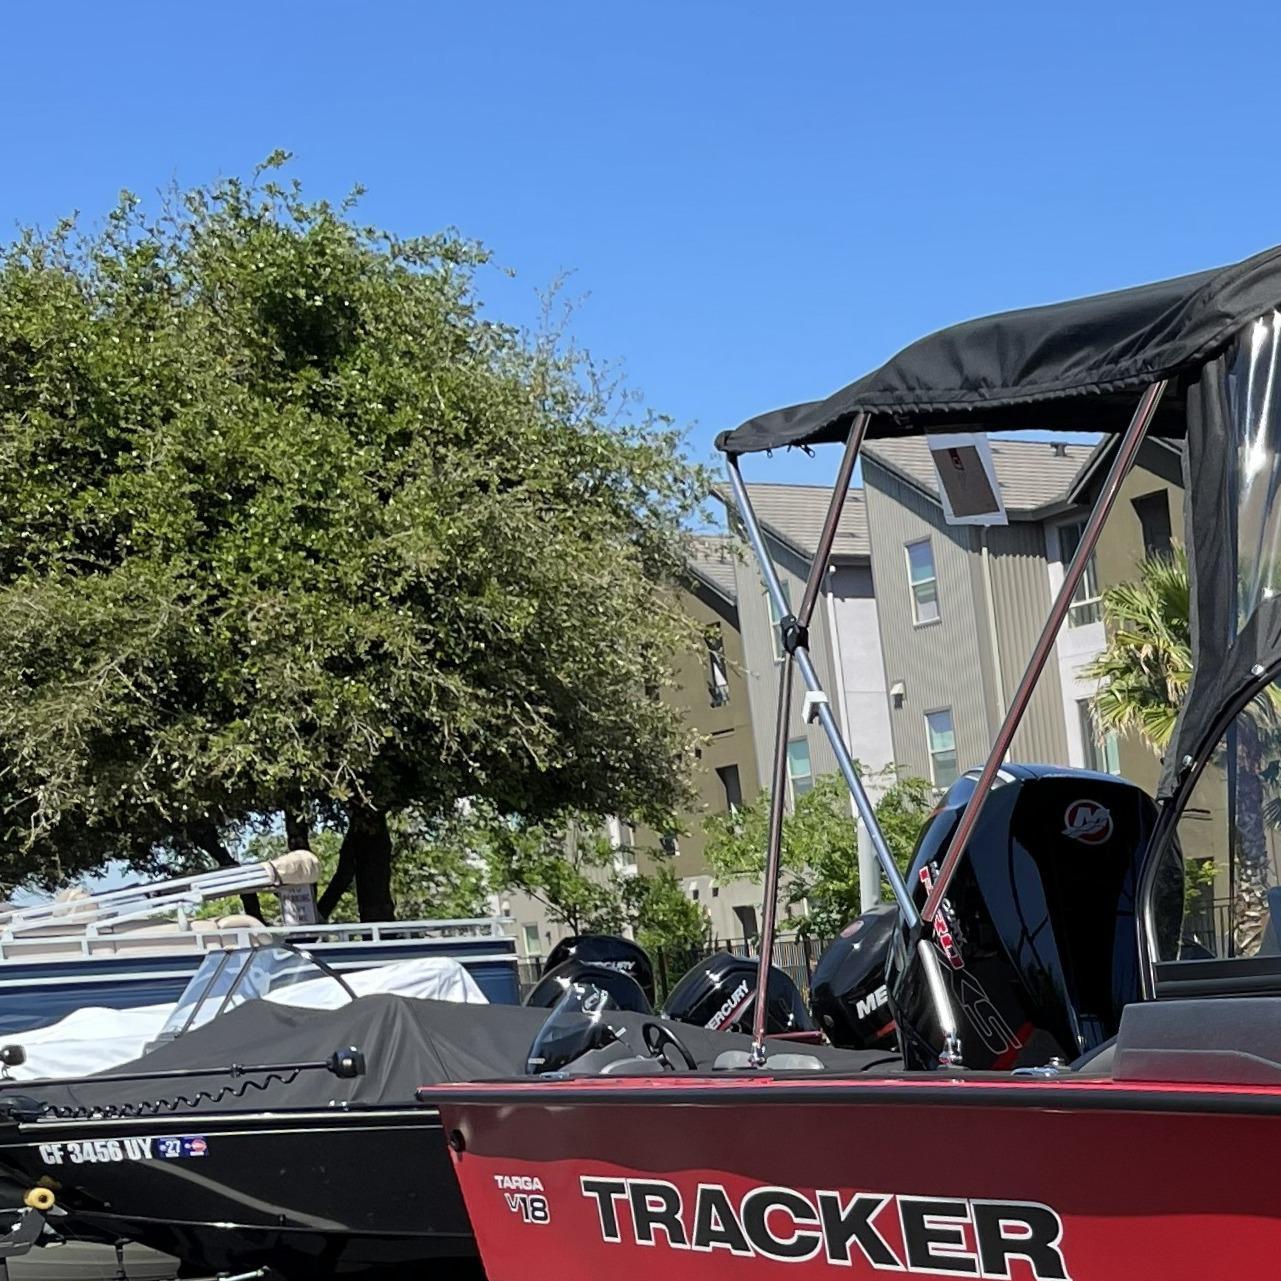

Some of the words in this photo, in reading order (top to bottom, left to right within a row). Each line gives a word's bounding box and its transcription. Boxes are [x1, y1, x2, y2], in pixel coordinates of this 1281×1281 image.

[705, 980, 749, 1030] ERCURY
[38, 1144, 64, 1164] CF
[67, 1140, 123, 1163] 3456
[124, 1137, 152, 1160] UY
[494, 1175, 544, 1191] TARGA
[504, 1193, 551, 1224] V18
